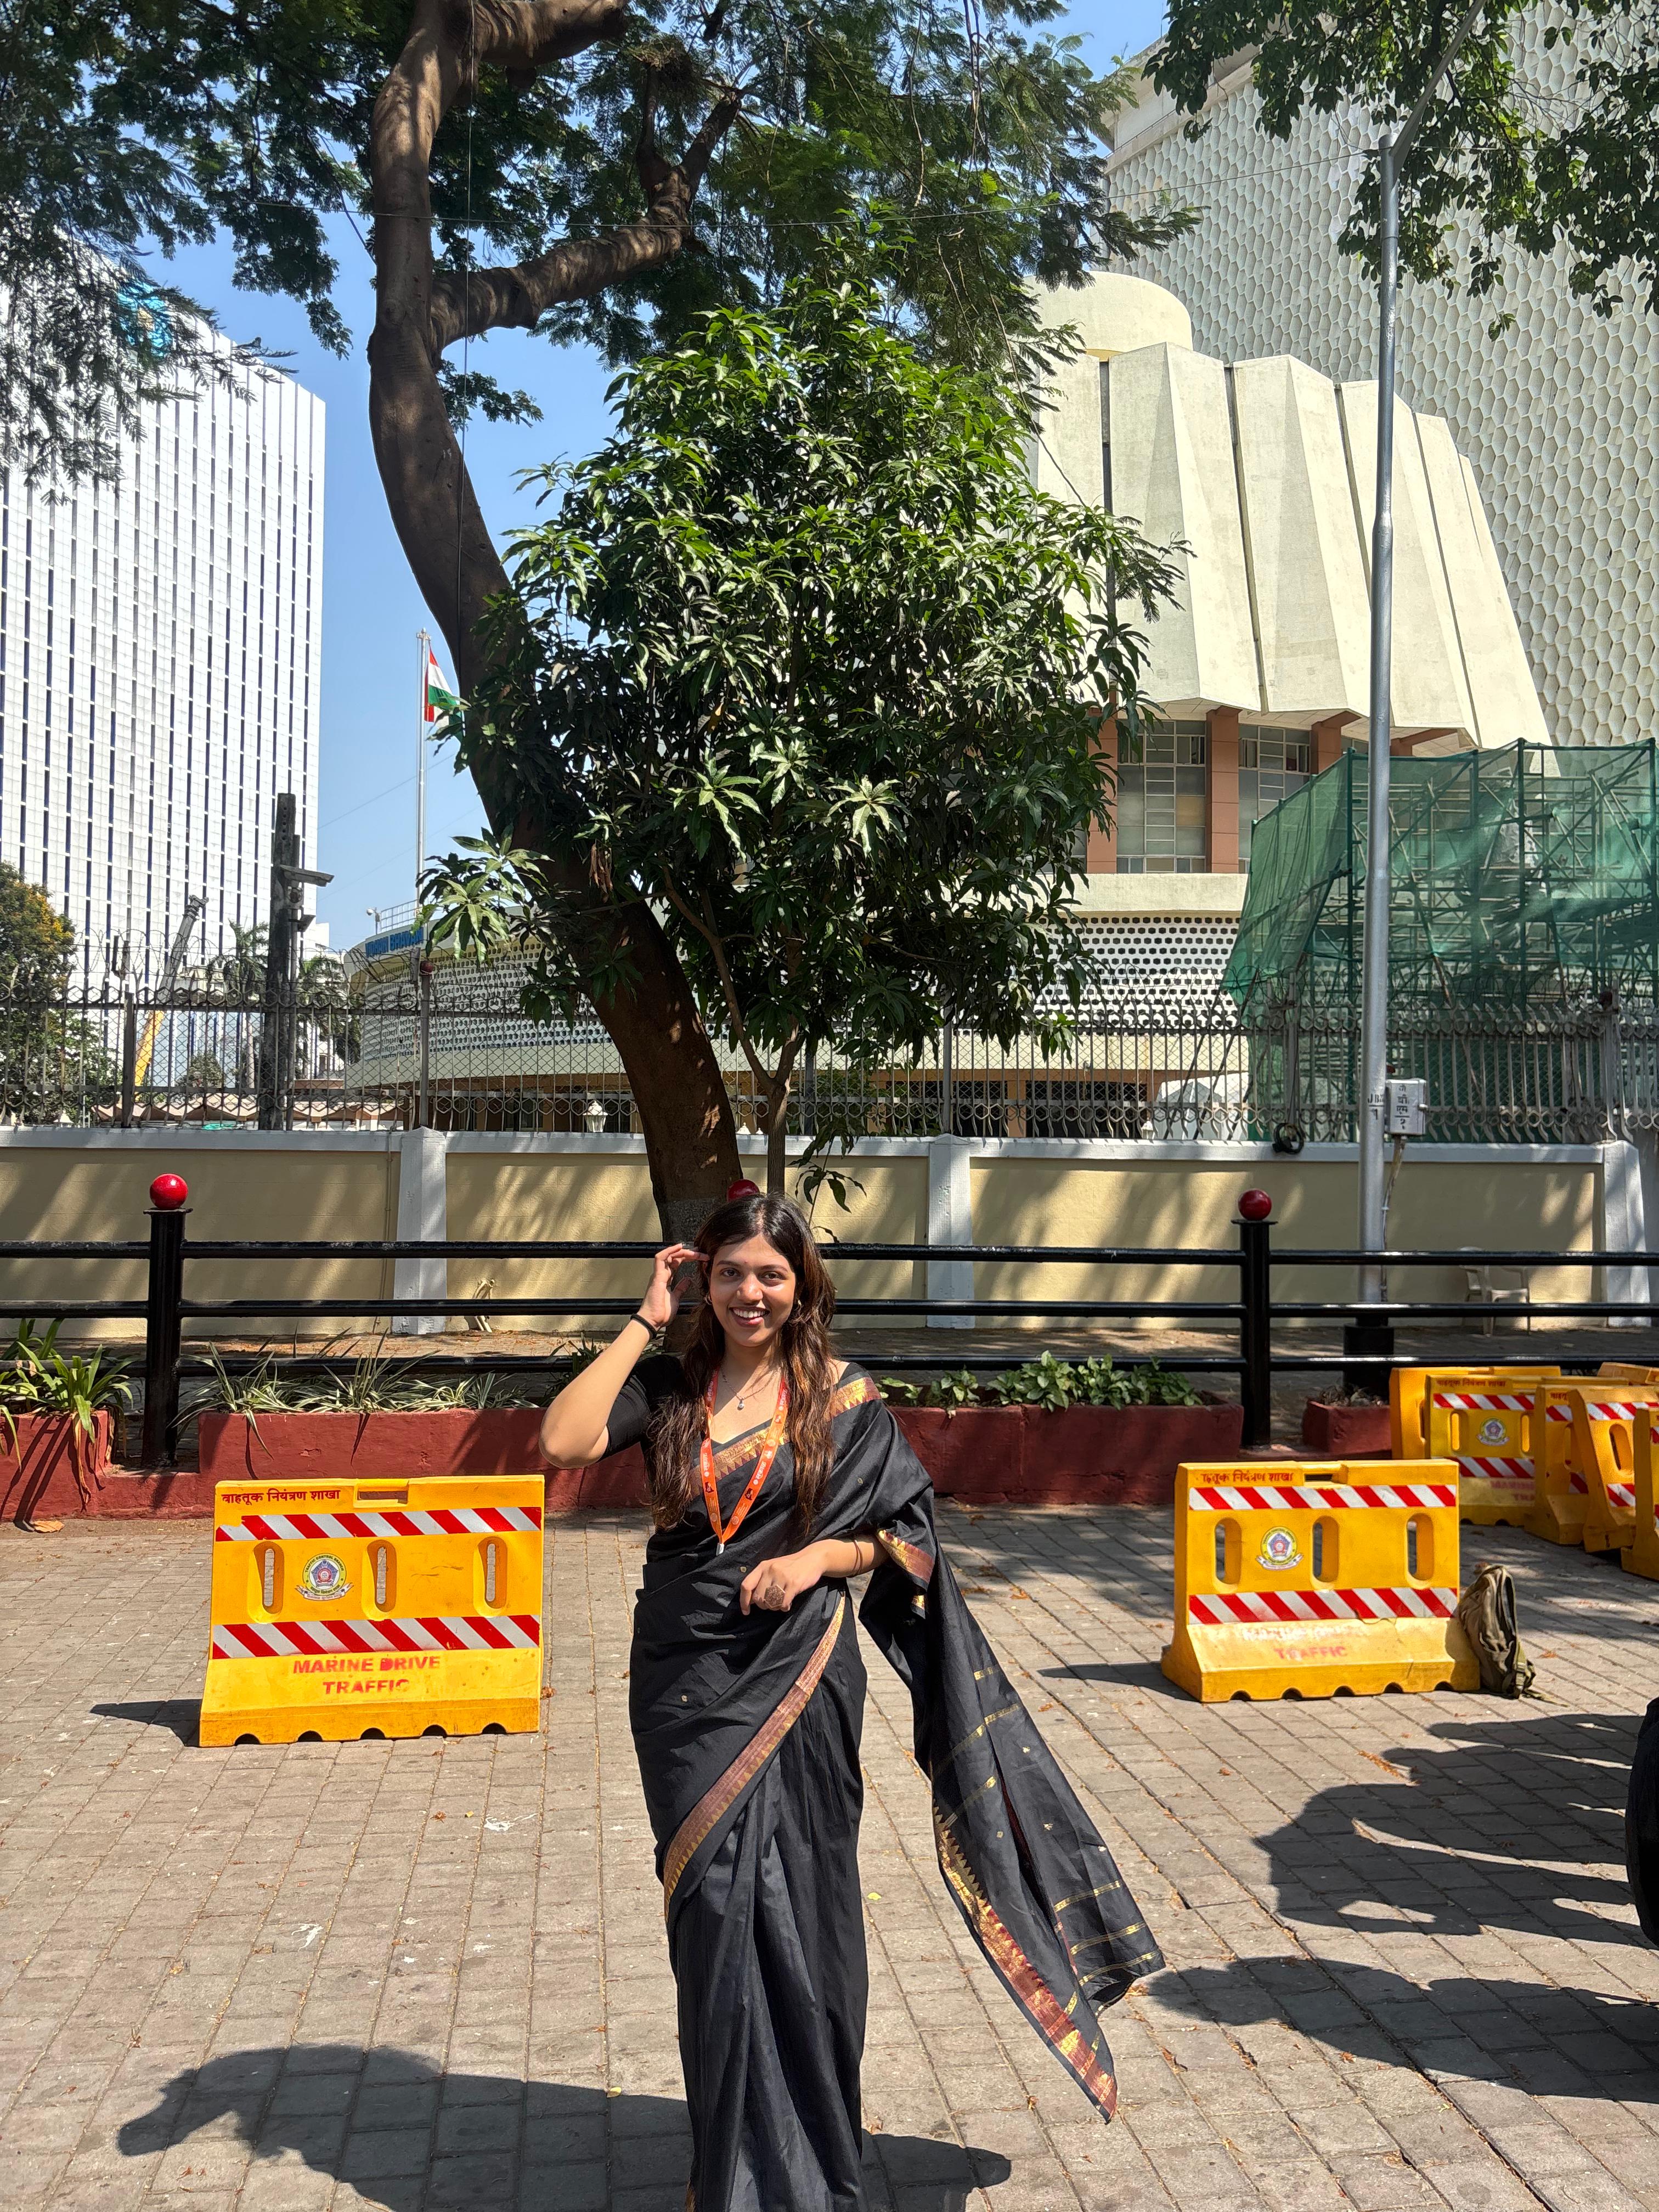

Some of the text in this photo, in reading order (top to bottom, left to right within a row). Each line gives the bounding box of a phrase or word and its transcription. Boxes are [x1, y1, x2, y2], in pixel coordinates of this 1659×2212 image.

[221, 1488, 341, 1505] वाहतूक नियंत्रण शाखा
[293, 1656, 440, 1674] MARINE DRIVE
[323, 1679, 409, 1695] TRAFFIC
